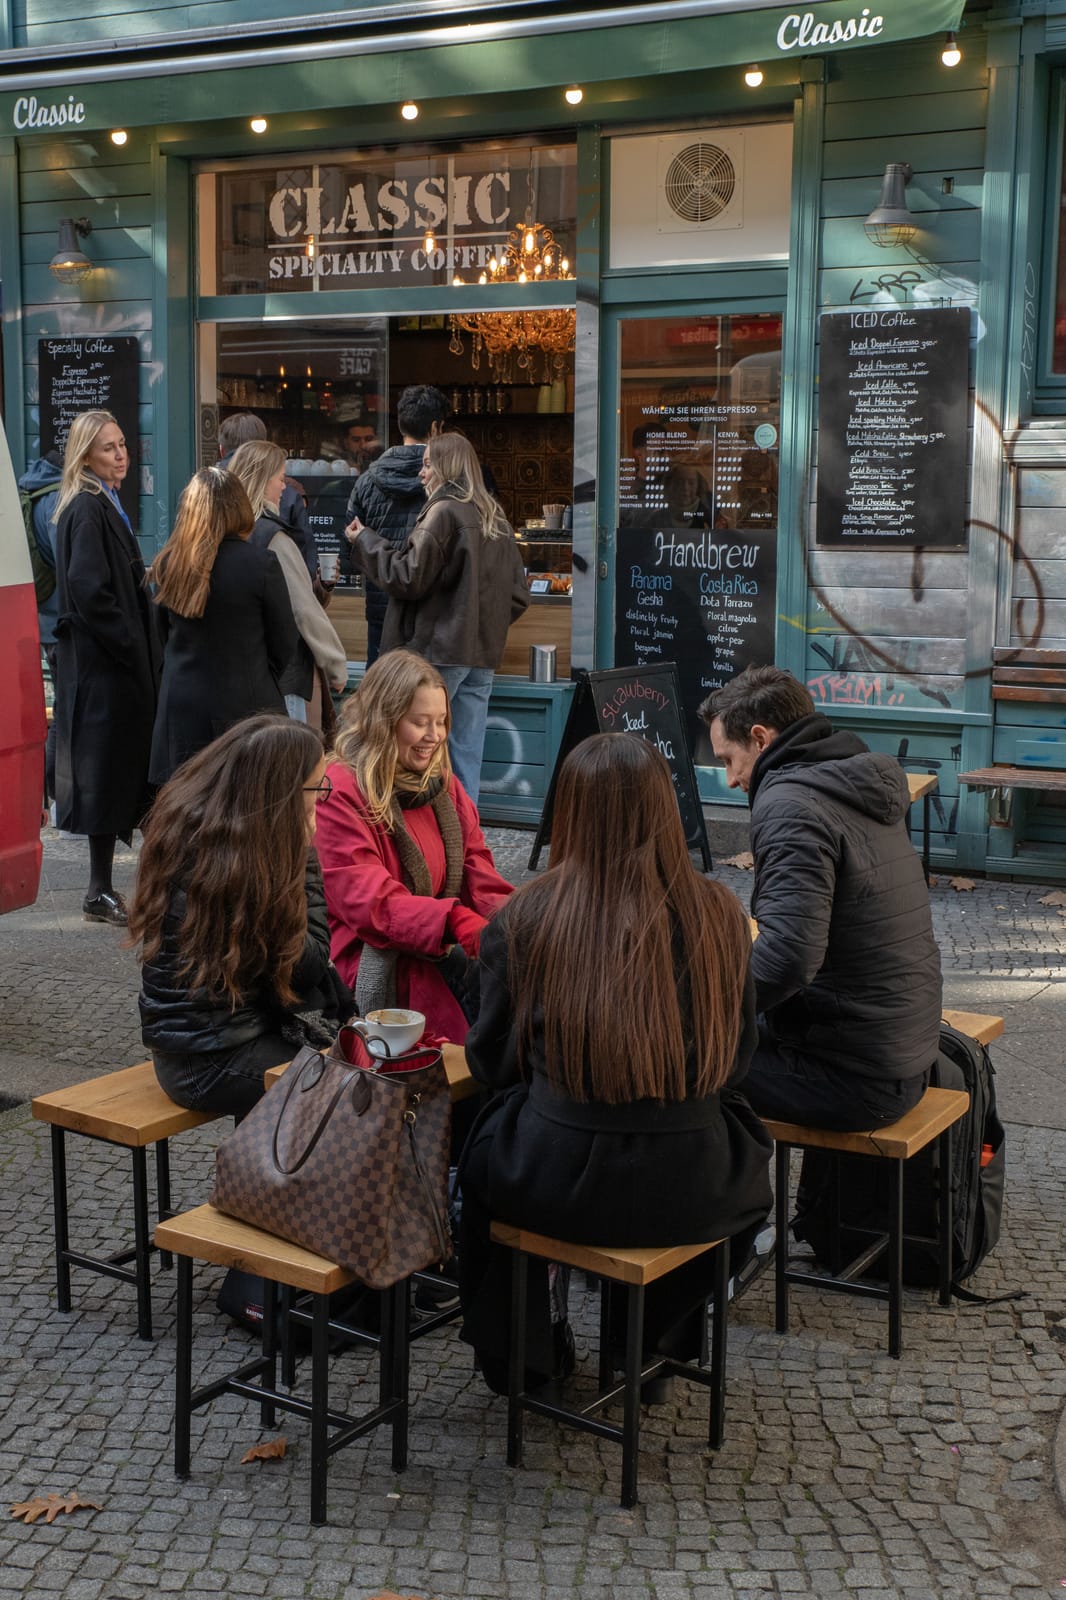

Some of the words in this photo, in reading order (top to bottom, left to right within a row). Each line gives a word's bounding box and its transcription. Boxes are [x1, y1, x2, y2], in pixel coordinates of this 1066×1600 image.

[777, 8, 884, 51] Classic
[13, 95, 86, 130] Classic
[268, 171, 511, 238] CLASSIC
[268, 249, 404, 280] SPECIALTY
[411, 243, 511, 272] COFFEE
[850, 313, 878, 329] ICED
[880, 312, 917, 327] Coffee
[48, 341, 82, 361] Specialty
[85, 339, 115, 354] Coffee
[851, 337, 868, 351] Iced
[857, 360, 874, 371] Iced
[865, 380, 880, 390] Iced
[857, 397, 871, 407] Iced
[641, 406, 675, 416] WÄHLEN
[676, 406, 689, 415] SIE
[691, 406, 716, 415] IHREN
[717, 405, 757, 414] ESPRESSO
[717, 431, 740, 439] KENYA
[308, 516, 334, 526] FFEE?
[655, 531, 760, 571] Handbrew
[630, 565, 672, 591] Panama
[700, 572, 734, 594] Costa
[734, 574, 758, 595] Rica
[637, 591, 664, 606] Gesha
[723, 595, 753, 608] Tarrazu
[728, 613, 757, 627] magnolia
[715, 648, 735, 659] grape
[602, 679, 670, 727] Strawberry
[622, 709, 649, 733] Iced
